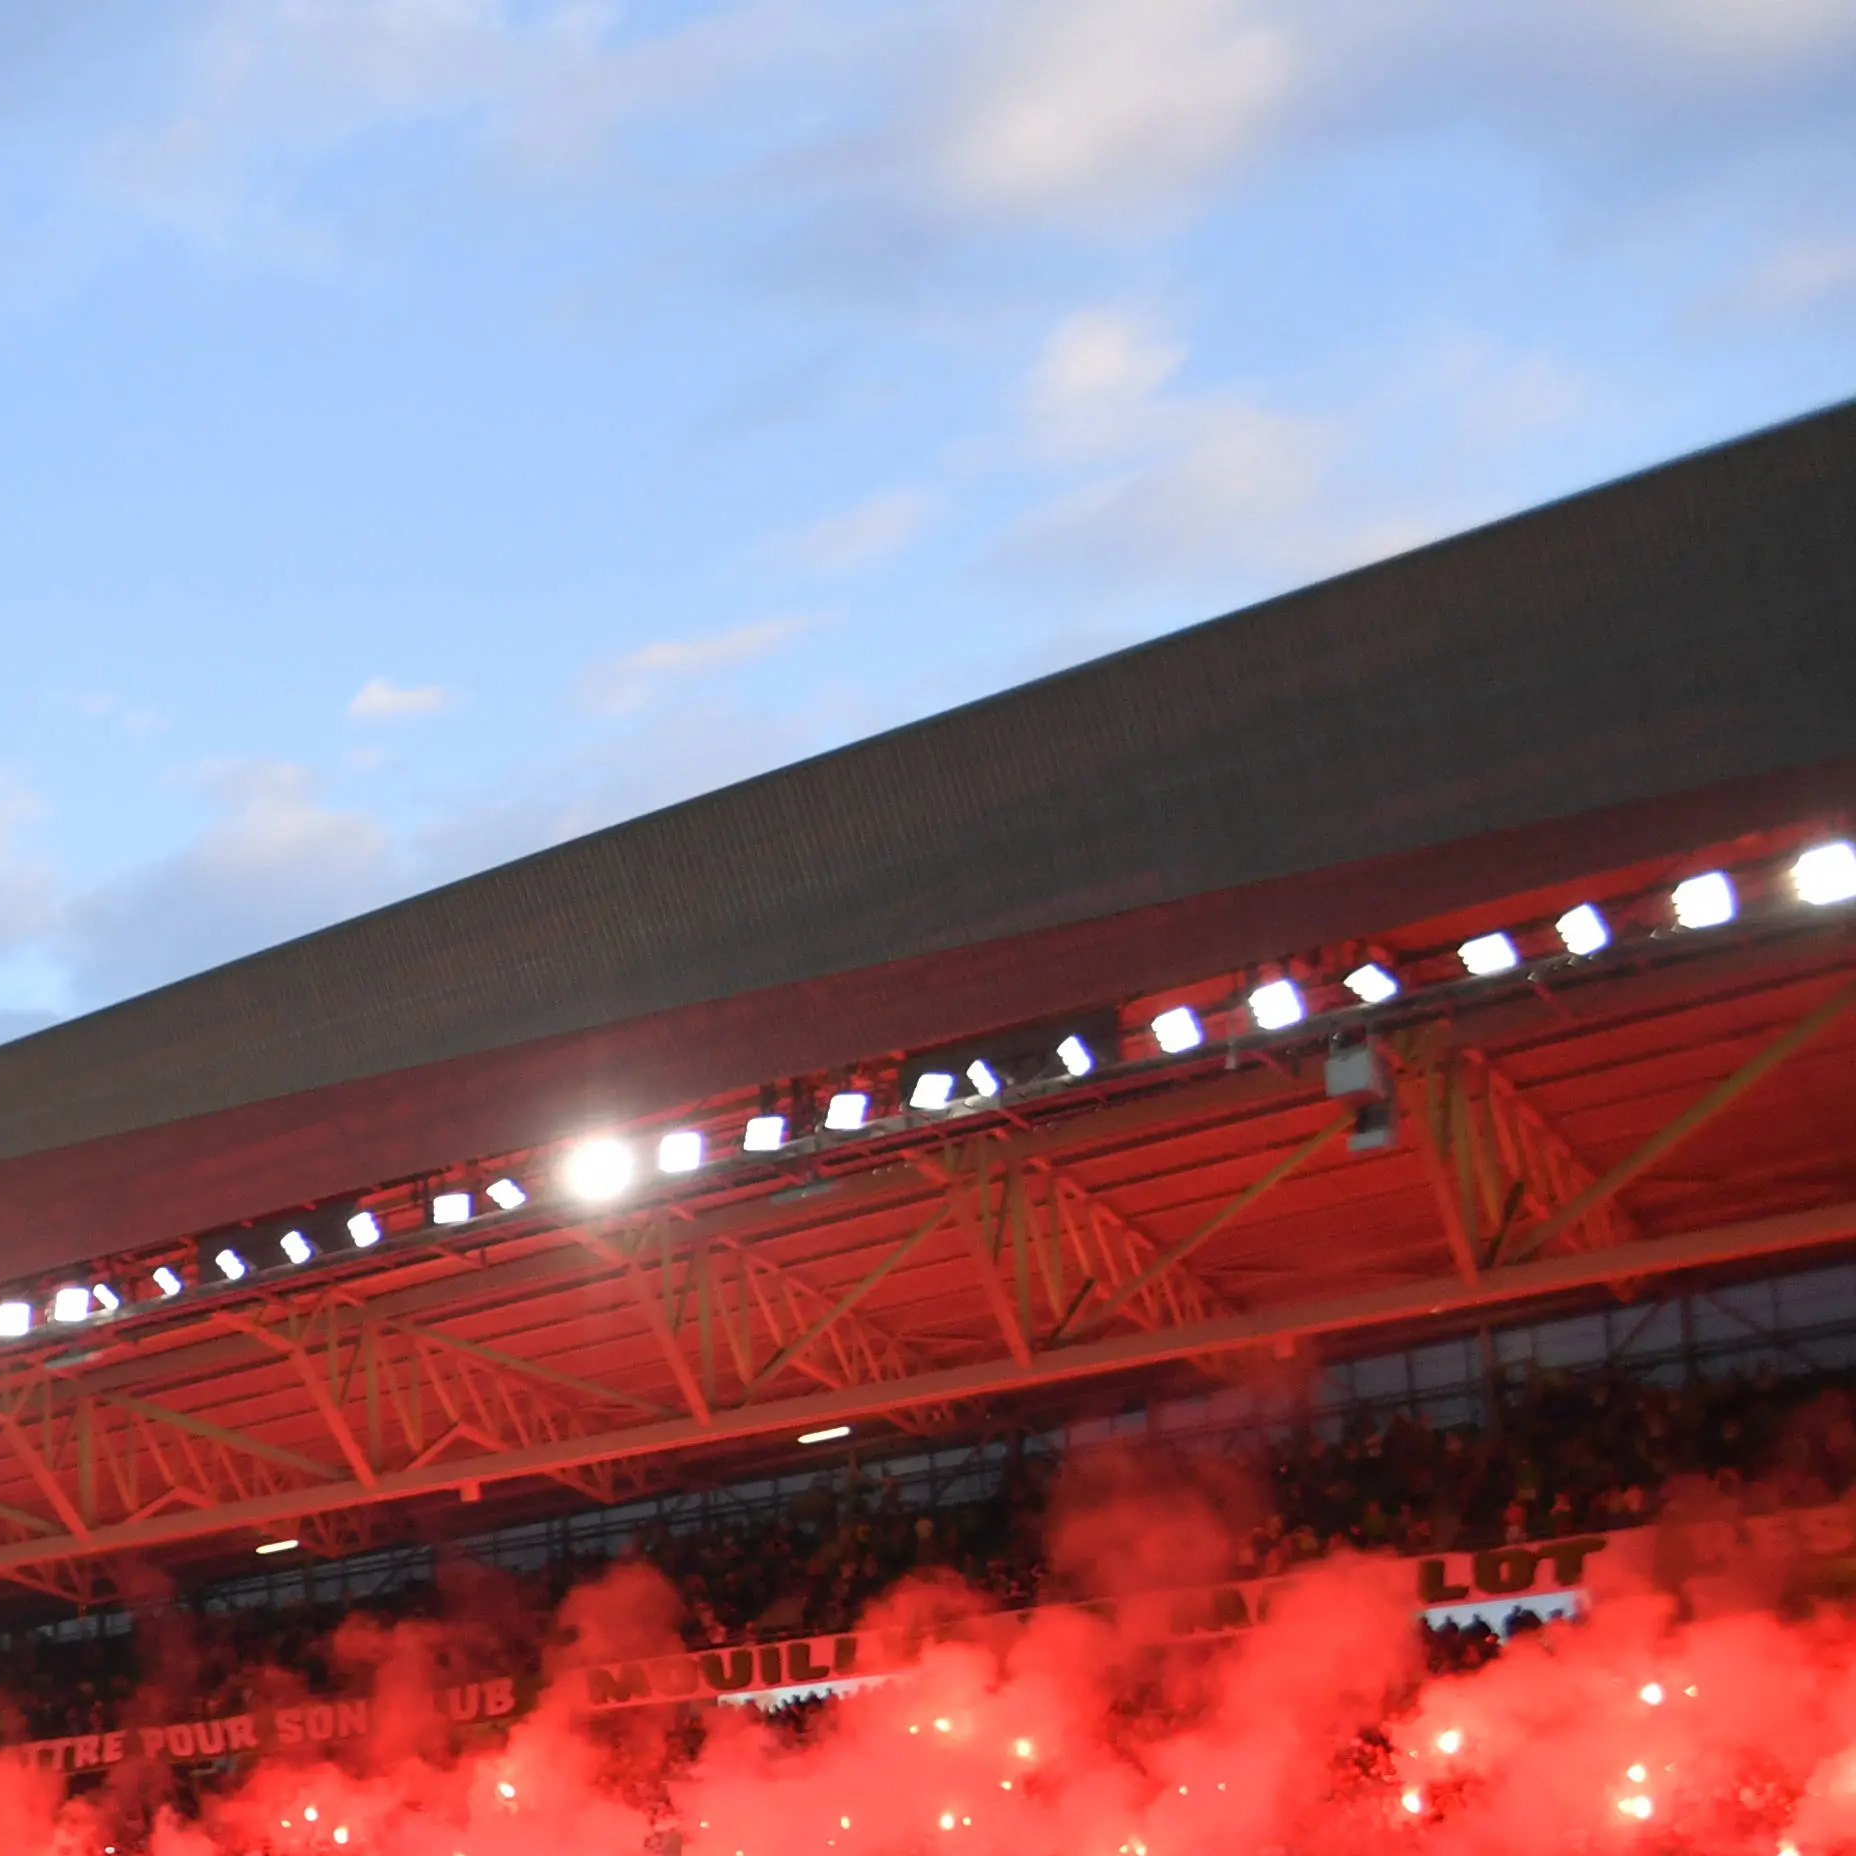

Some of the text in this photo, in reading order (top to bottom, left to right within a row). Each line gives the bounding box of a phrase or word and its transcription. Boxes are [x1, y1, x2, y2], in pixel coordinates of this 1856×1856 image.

[140, 1714, 259, 1760] POUR
[274, 1700, 369, 1745] SON
[448, 1677, 516, 1722] UB
